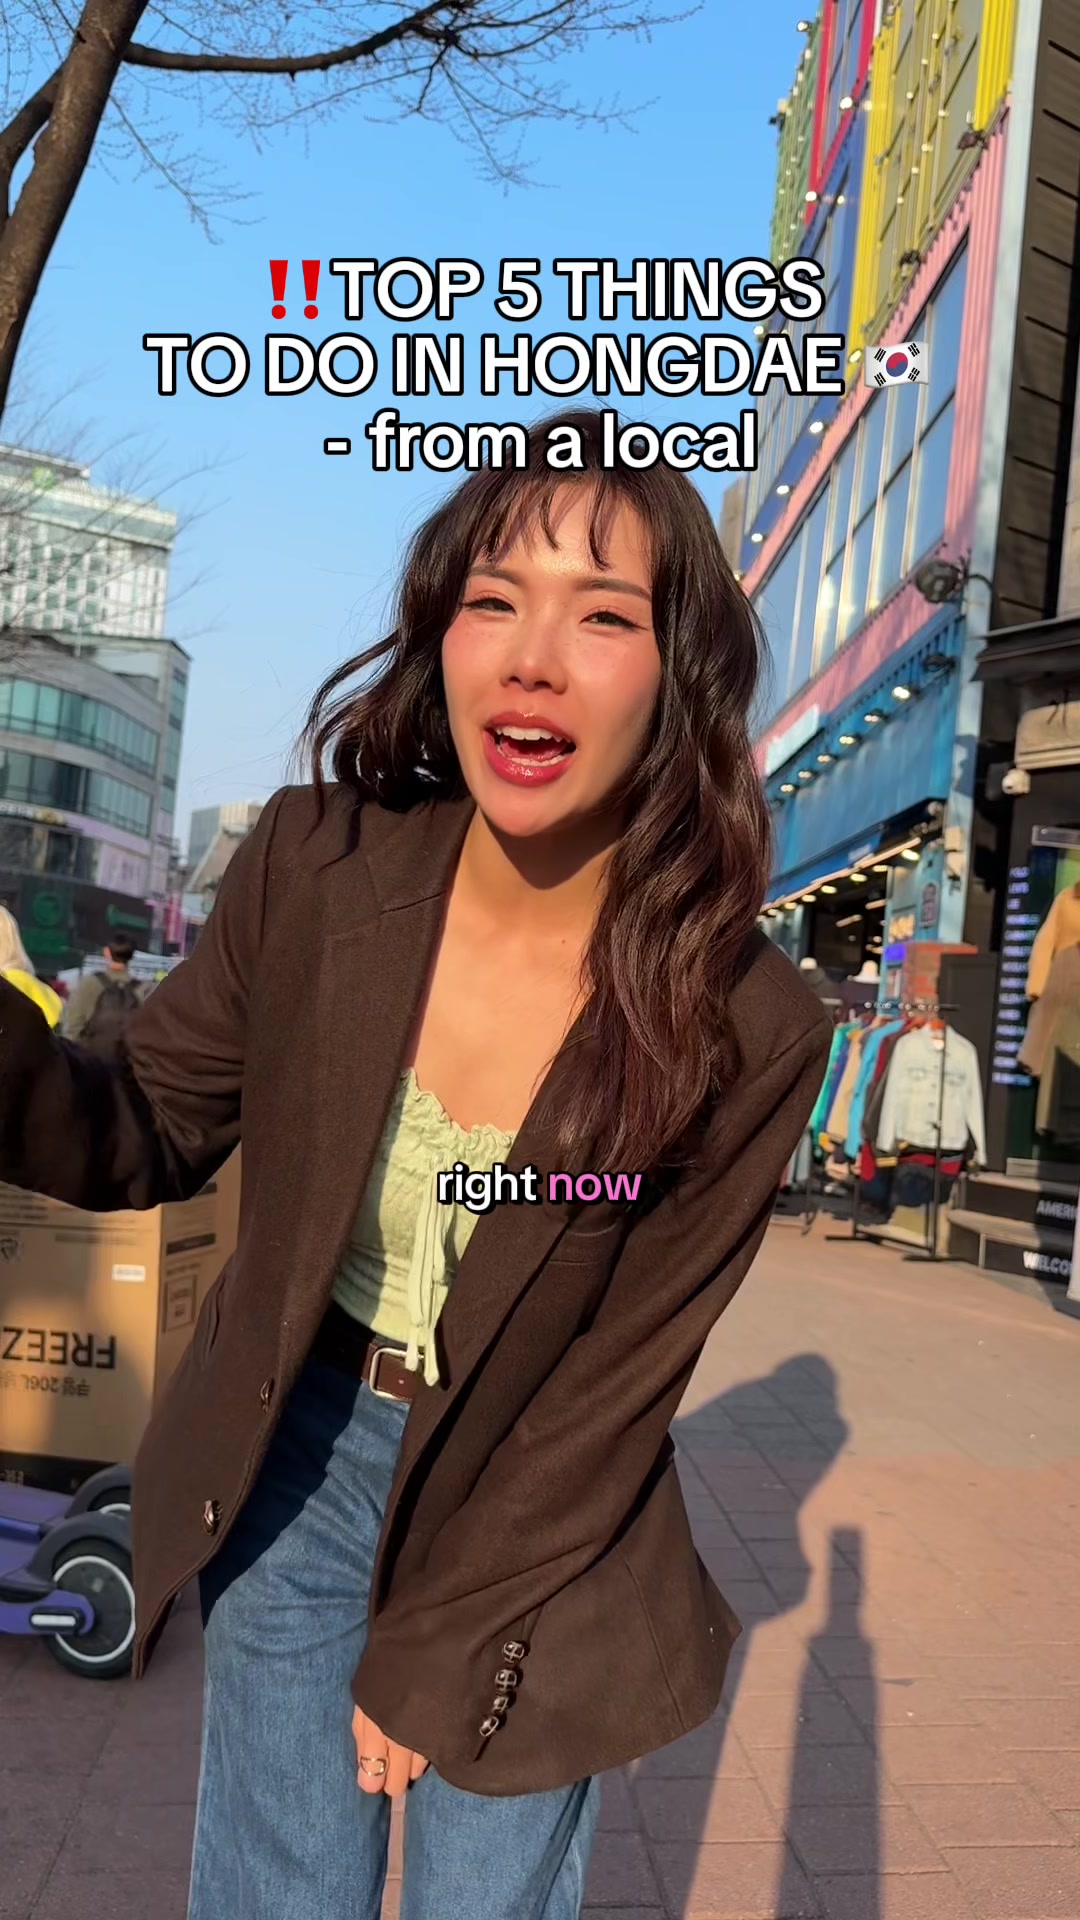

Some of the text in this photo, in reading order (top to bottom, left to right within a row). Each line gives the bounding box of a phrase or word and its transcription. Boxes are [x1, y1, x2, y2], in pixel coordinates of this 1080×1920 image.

[1036, 1200, 1077, 1220] AMERI
[1023, 1250, 1073, 1276] WELCO
[2, 1326, 116, 1370] FREEZ
